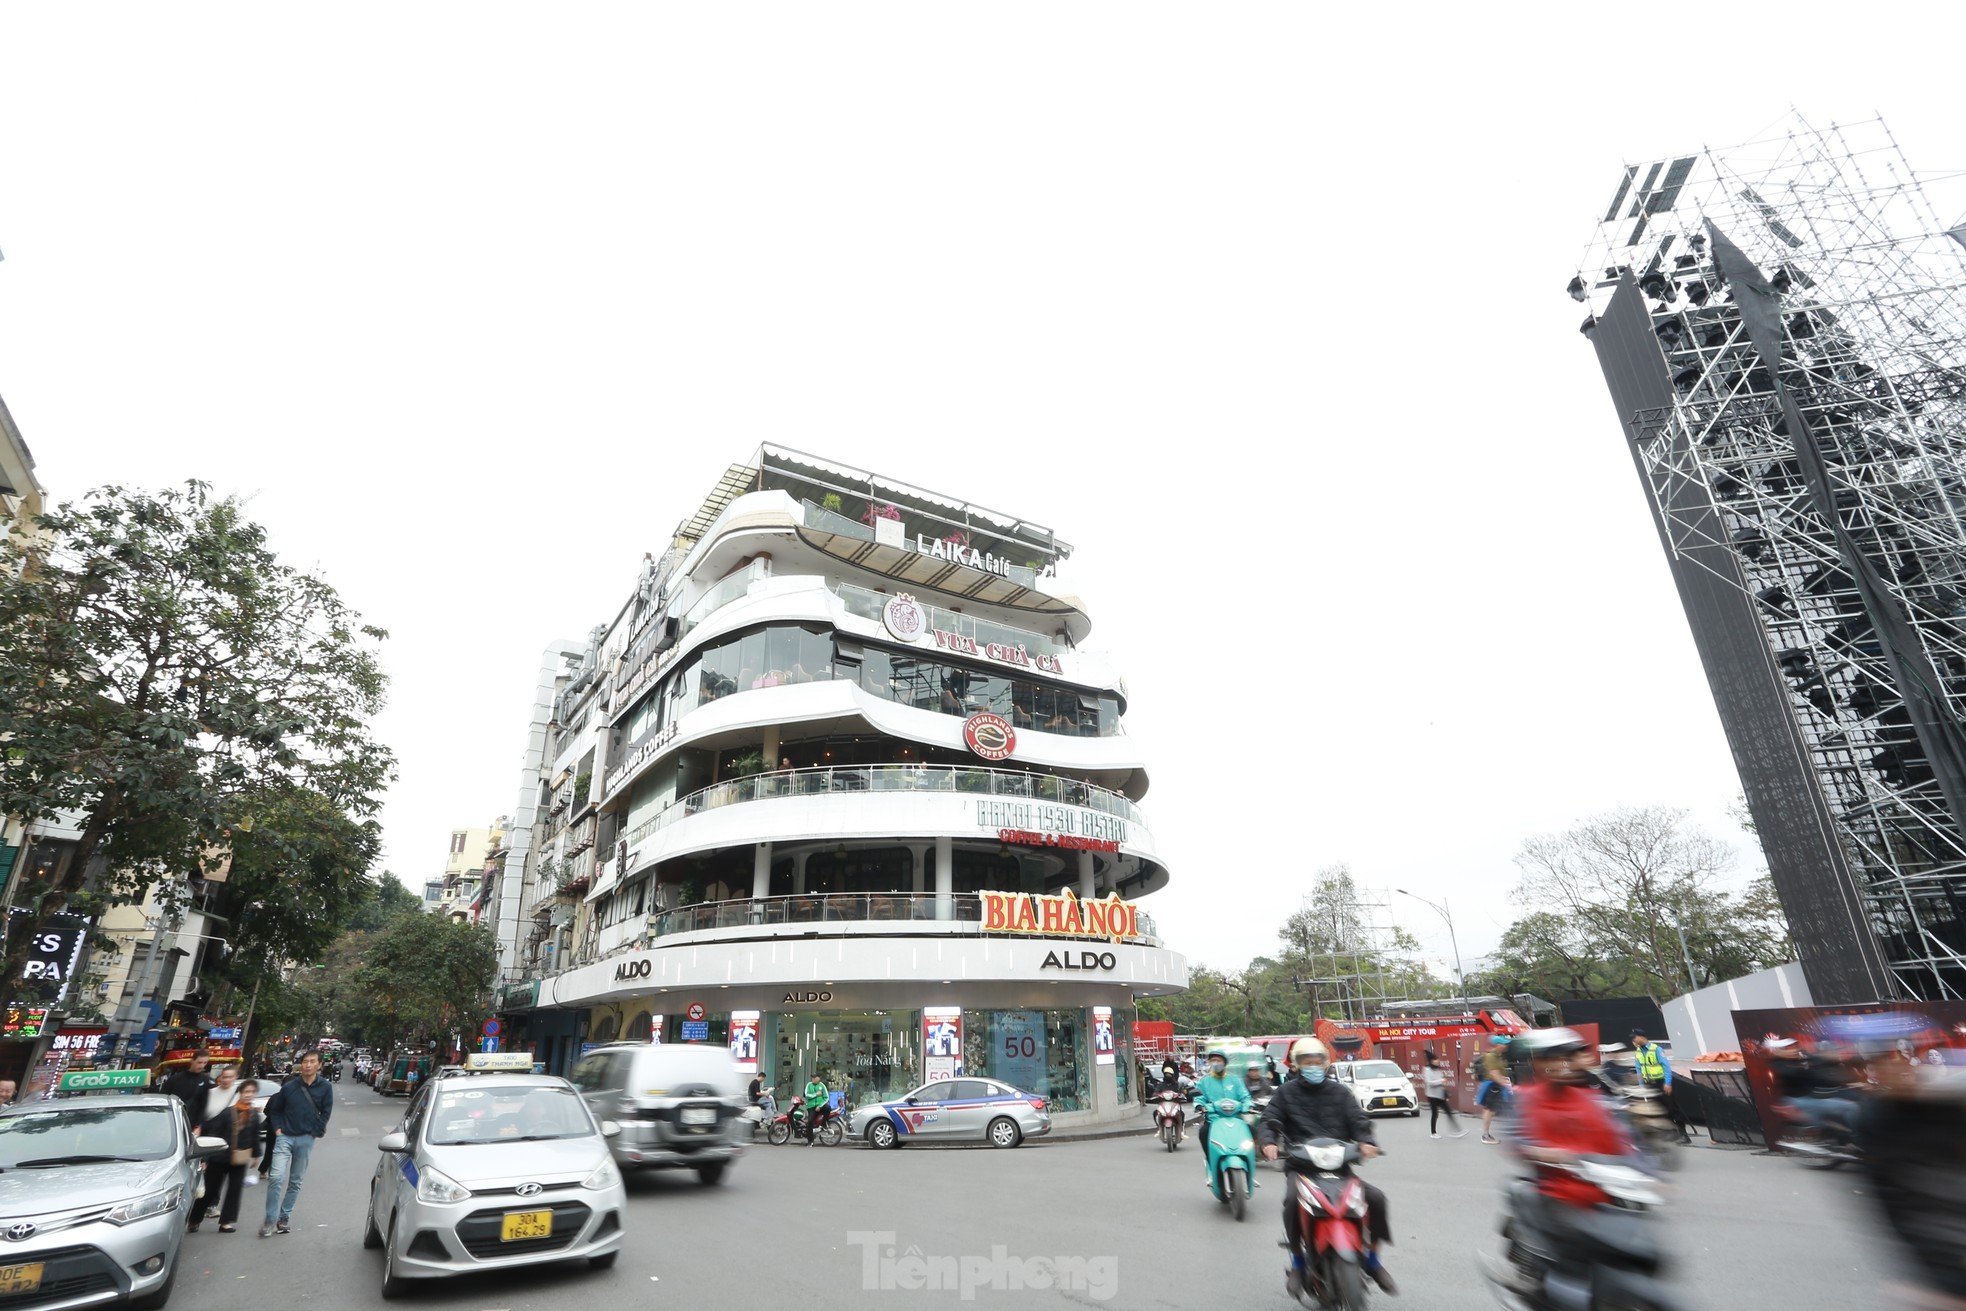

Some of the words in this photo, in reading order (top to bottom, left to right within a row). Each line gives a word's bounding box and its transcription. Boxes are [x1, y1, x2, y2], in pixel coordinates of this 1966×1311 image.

[917, 533, 982, 570] LAIKA
[985, 552, 1010, 577] Café
[932, 629, 977, 655] VUA
[986, 643, 1030, 667] CHẢ
[1036, 655, 1063, 675] CÁ
[968, 716, 1014, 739] HIGHLANDS
[606, 747, 644, 793] HIGHLANDS
[643, 720, 678, 757] COFFEE
[973, 744, 1009, 758] COFFEE
[977, 799, 1033, 829] HANOI
[1037, 804, 1076, 833] 1930
[1081, 811, 1129, 843] BISTRO
[984, 894, 1037, 931] BIA
[1041, 891, 1084, 933] HÀ
[1087, 896, 1138, 944] NỘI
[614, 959, 652, 982] ALDO
[1040, 950, 1117, 971] ALDO
[783, 991, 833, 1004] ALDO
[53, 1035, 71, 1049] SIM
[1402, 1028, 1417, 1036] CITY
[1418, 1028, 1436, 1036] TOUR
[1005, 1036, 1036, 1059] 50
[69, 1074, 110, 1087] Grab
[113, 1076, 140, 1085] TAXI
[924, 1114, 938, 1122] TAXI
